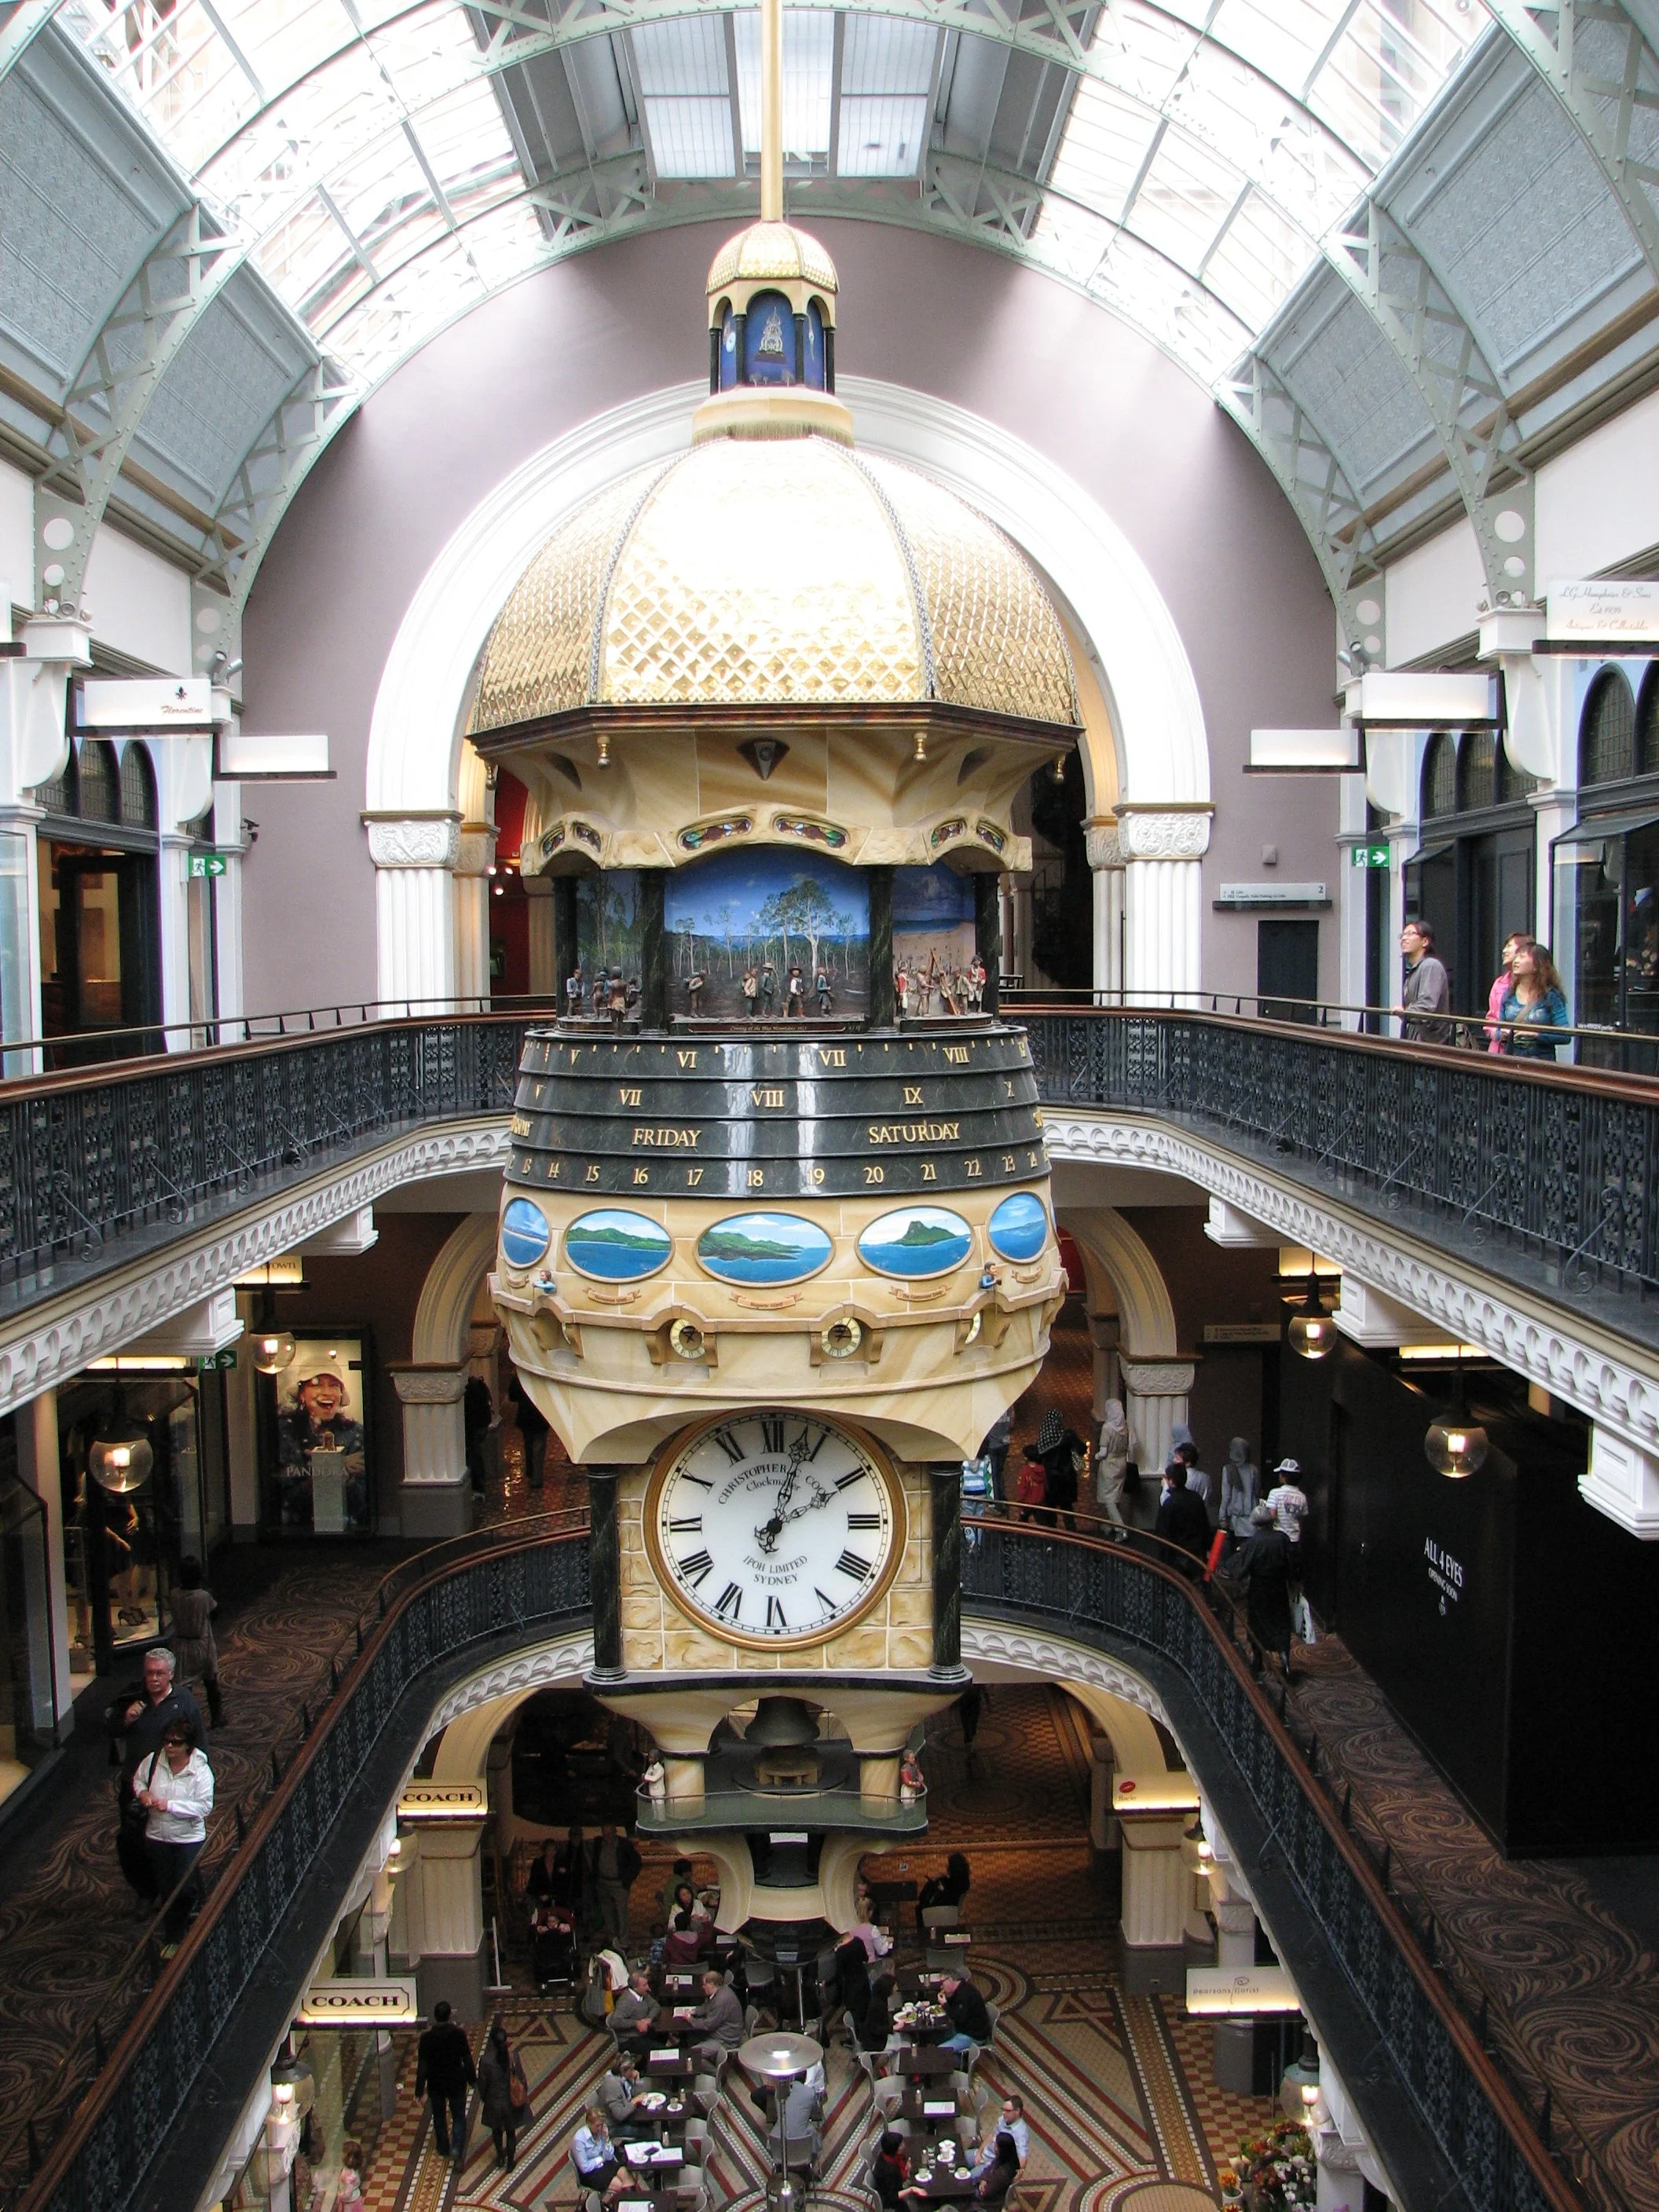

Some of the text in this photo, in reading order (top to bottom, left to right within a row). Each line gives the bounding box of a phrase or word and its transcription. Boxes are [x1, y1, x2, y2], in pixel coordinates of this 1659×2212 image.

[160, 705, 203, 716] Florentine
[677, 1051, 698, 1068] VI
[819, 1049, 846, 1067] VII
[943, 1046, 969, 1064] VIII
[620, 1089, 643, 1106] VII
[750, 1090, 786, 1108] VIII
[903, 1087, 923, 1104] IX
[632, 1128, 701, 1147] FRIDAY
[869, 1123, 959, 1143] SATURDAY
[586, 1165, 600, 1181] 15
[633, 1167, 648, 1185] 16
[687, 1169, 704, 1186] 17
[747, 1170, 764, 1187] 18
[808, 1168, 825, 1185] 19
[863, 1166, 884, 1185] 20
[921, 1164, 936, 1181] 21
[965, 1160, 982, 1177] 22
[1002, 1155, 1016, 1173] 23
[718, 1464, 786, 1505] CHRISTOPHER
[743, 1555, 808, 1573] IPOH LIMITED
[1423, 1536, 1463, 1588] ALL 4 EYES
[753, 1573, 798, 1586] SYDNEY
[402, 1793, 473, 1802] COACH
[311, 1996, 399, 2007] COACH
